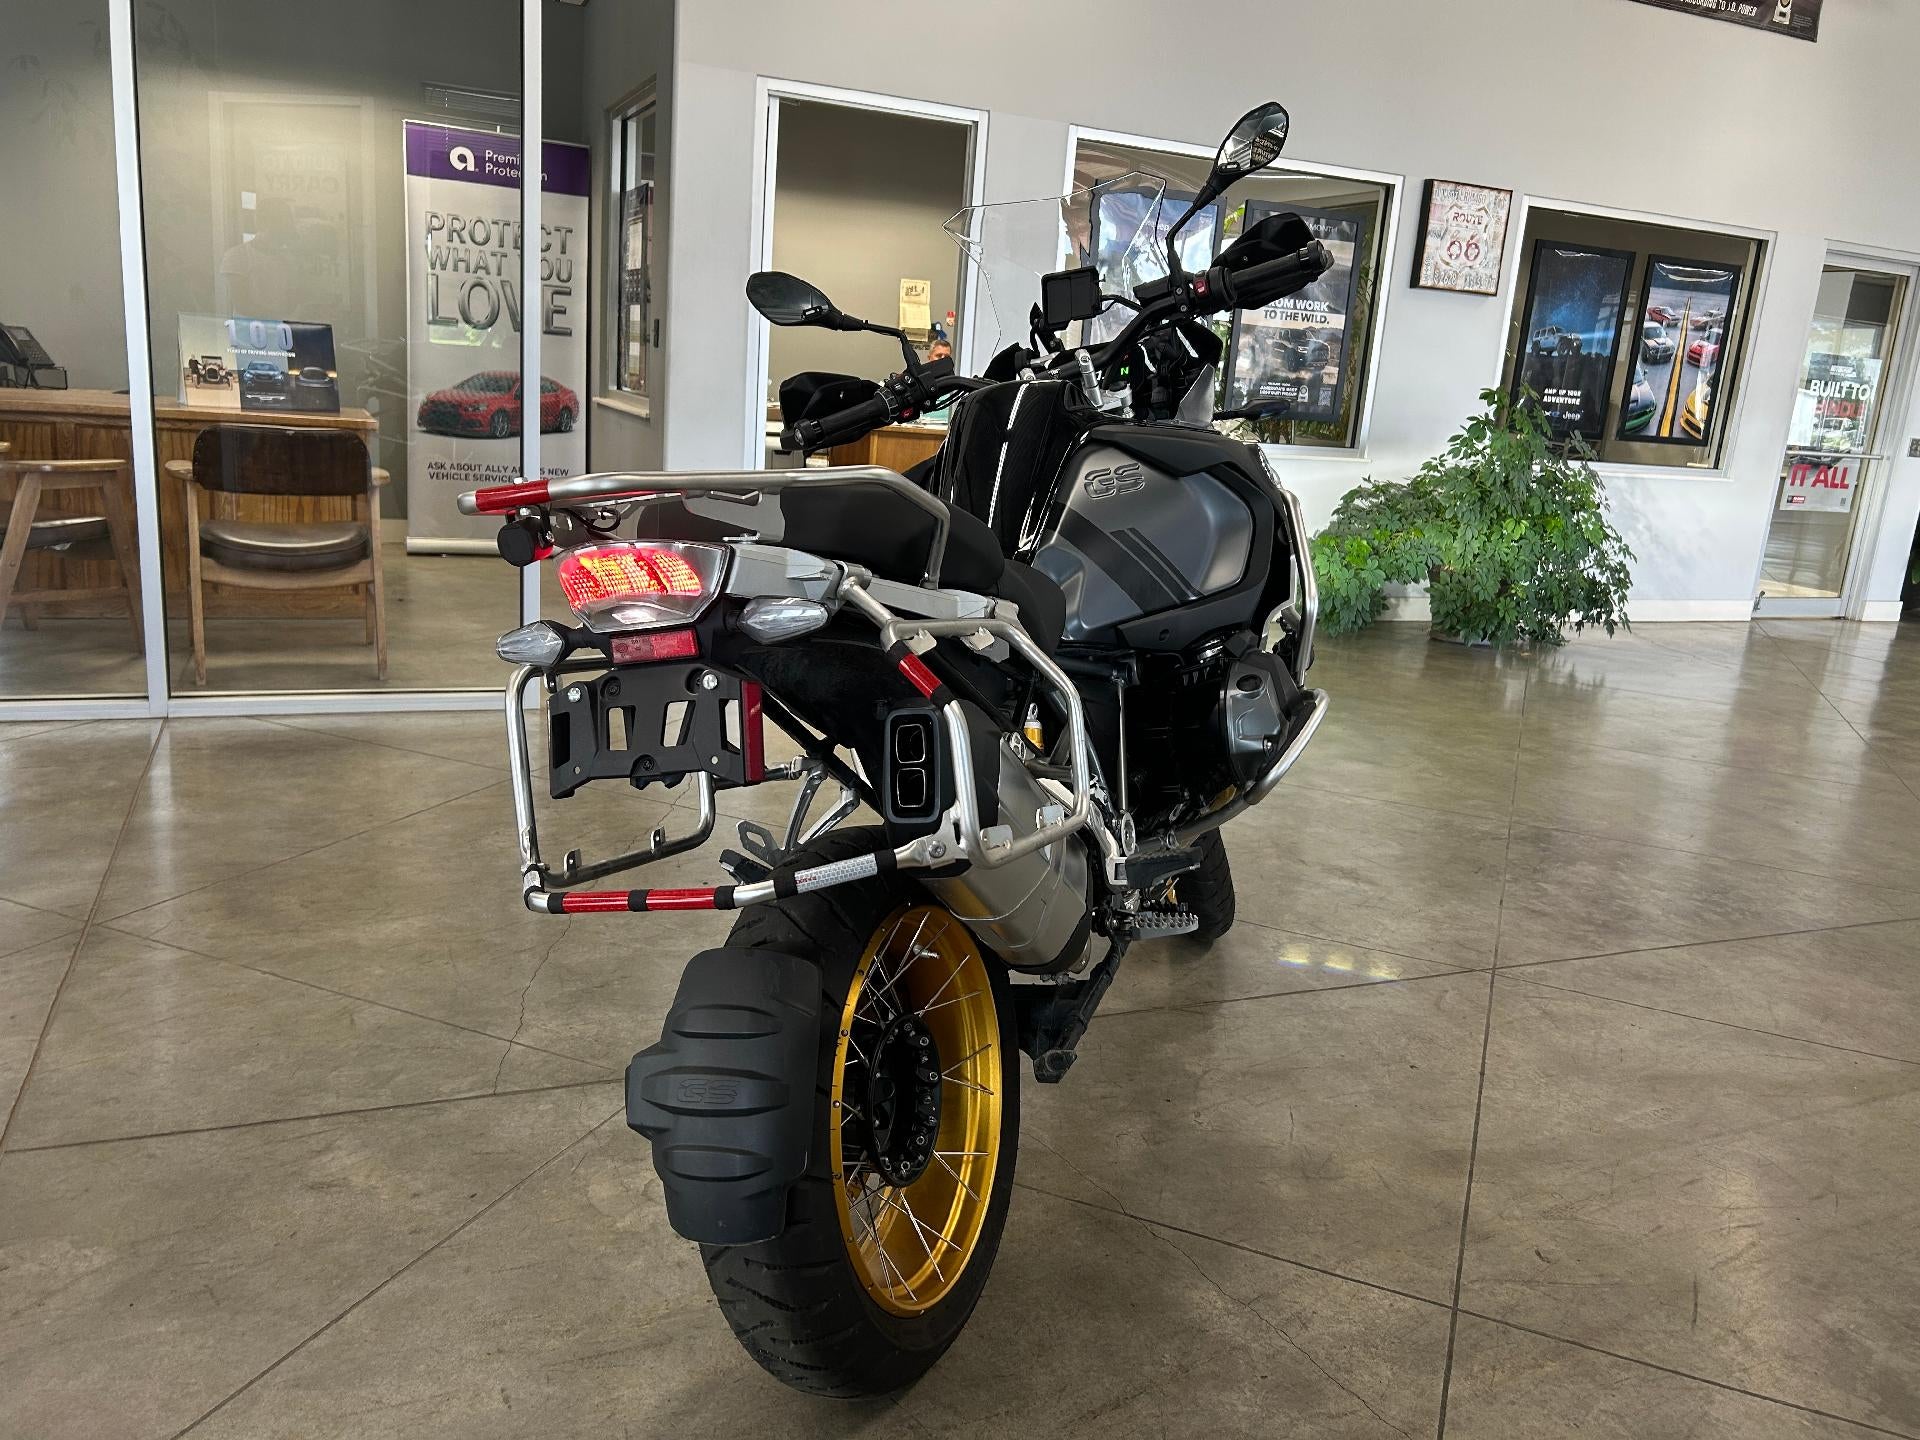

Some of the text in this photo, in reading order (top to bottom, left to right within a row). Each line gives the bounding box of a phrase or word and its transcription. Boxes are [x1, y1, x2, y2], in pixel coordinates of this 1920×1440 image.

[1718, 0, 1727, 11] TO
[1738, 4, 1758, 17] POWER
[485, 149, 521, 166] Premi
[1453, 212, 1484, 225] ROUTE
[1310, 223, 1338, 233] MONTH
[424, 245, 508, 277] WHAT
[426, 273, 573, 337] LOVE
[1295, 299, 1330, 312] WORK
[1263, 309, 1330, 325] TO THE WILD.
[1120, 366, 1129, 376] N
[1809, 379, 1871, 401] BUILT TO
[1542, 395, 1581, 406] ADVENTURE
[1562, 410, 1581, 421] Jeep
[427, 461, 446, 471] ASK
[449, 462, 483, 472] ABOUT
[484, 464, 509, 474] ALLY
[548, 467, 569, 477] NEW
[428, 471, 469, 482] VEHICLE
[1789, 463, 1850, 490] IT ALL
[1083, 463, 1146, 500] GS
[677, 1078, 740, 1105] GS
